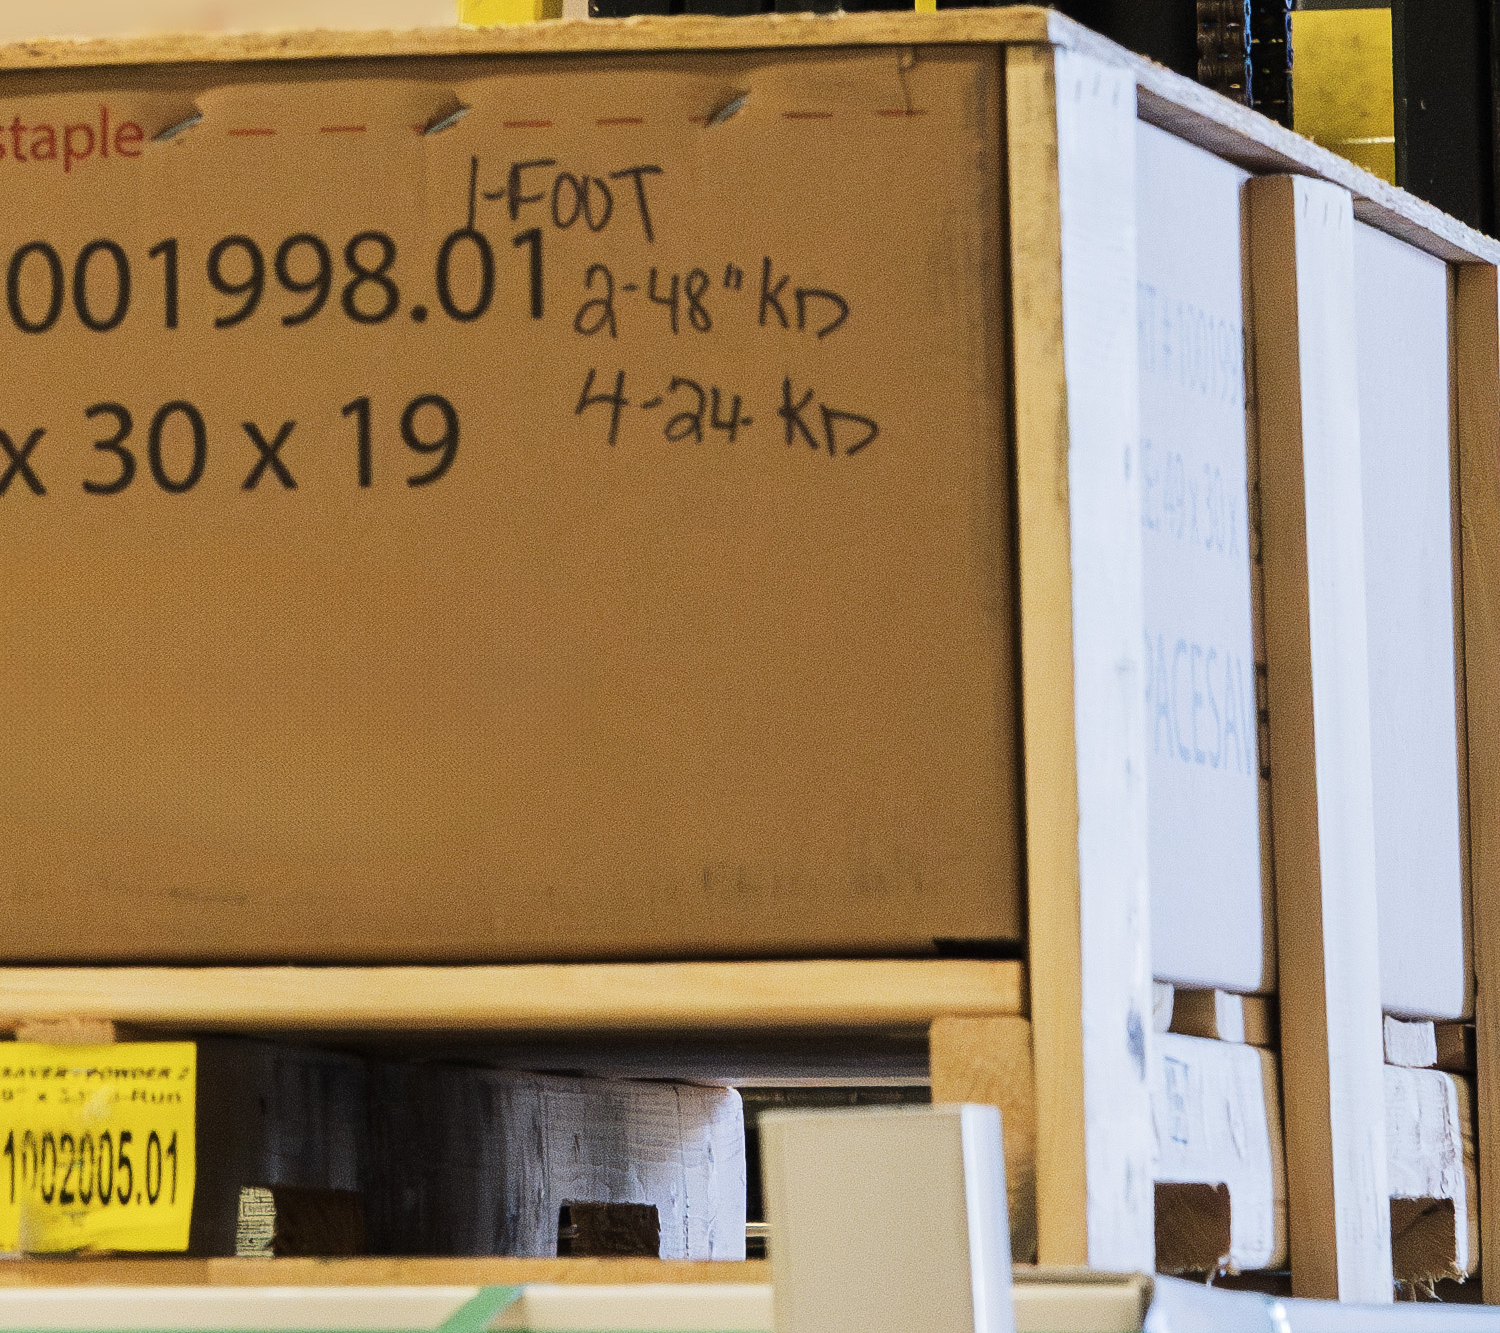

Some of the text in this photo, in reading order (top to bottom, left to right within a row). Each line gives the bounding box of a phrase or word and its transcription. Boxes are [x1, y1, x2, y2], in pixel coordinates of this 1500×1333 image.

[82, 398, 207, 496] 30
[241, 419, 300, 491] x
[340, 392, 462, 489] 19
[2, 1128, 179, 1206] 1002005.01
